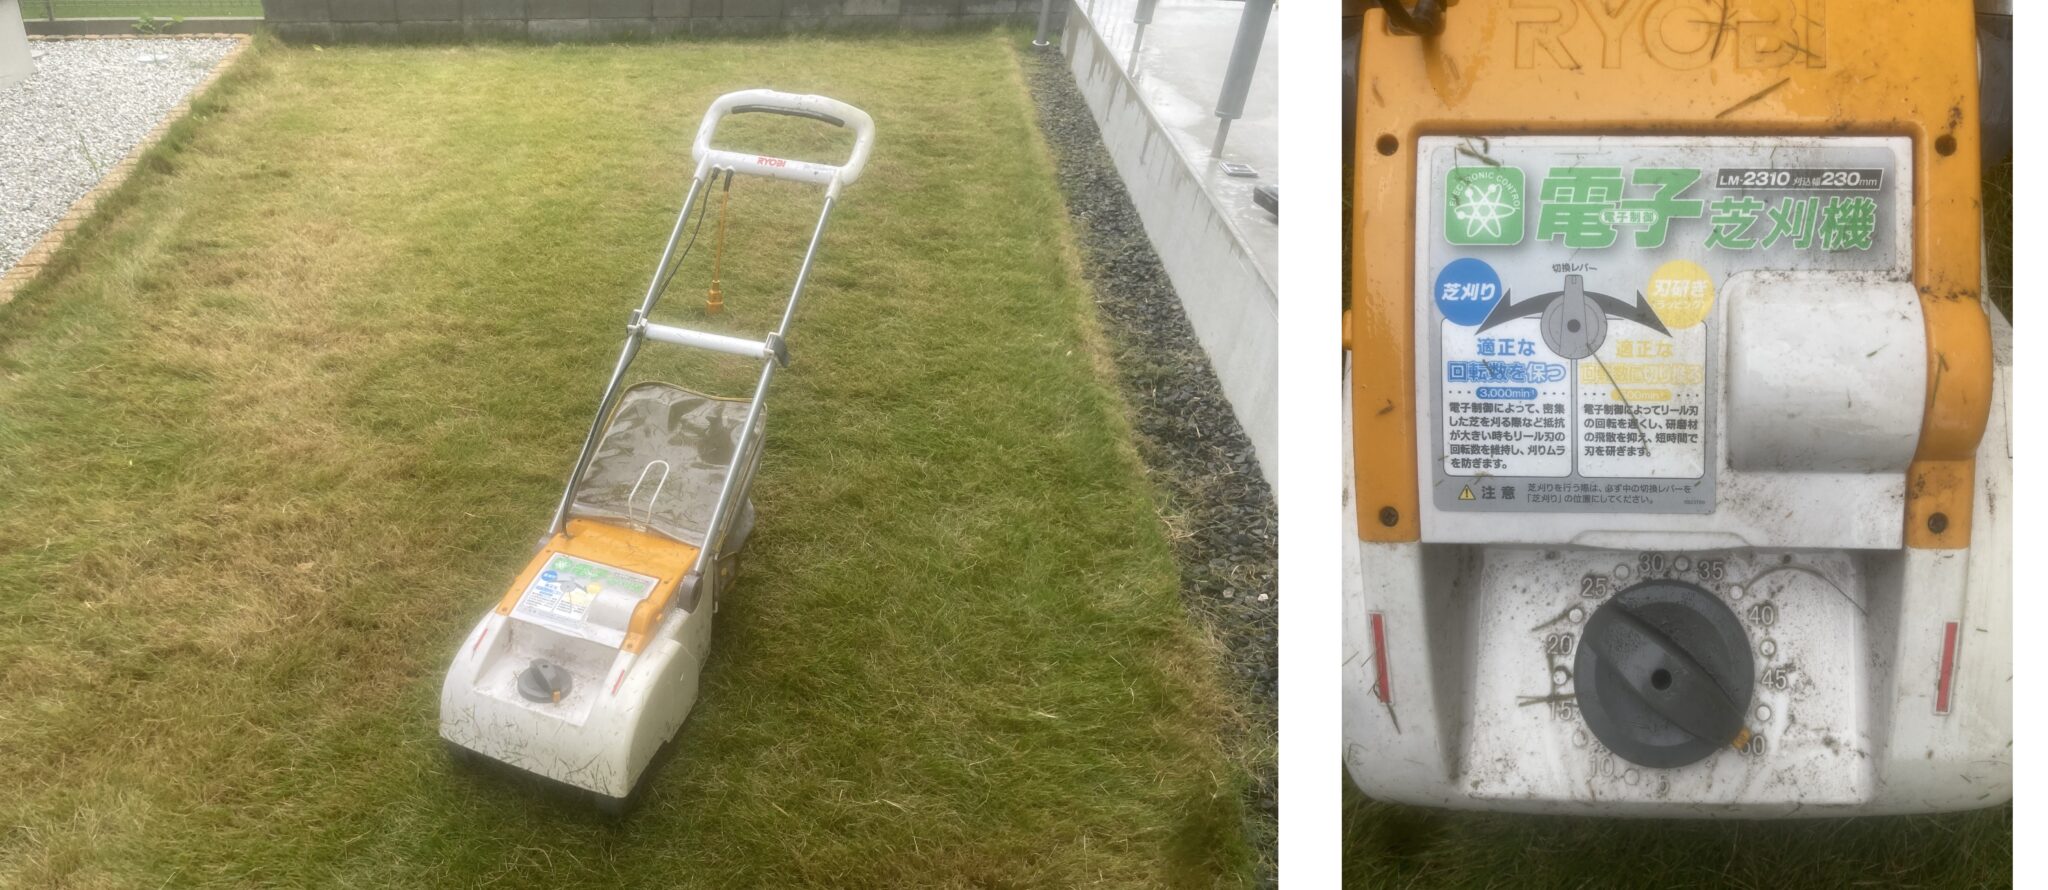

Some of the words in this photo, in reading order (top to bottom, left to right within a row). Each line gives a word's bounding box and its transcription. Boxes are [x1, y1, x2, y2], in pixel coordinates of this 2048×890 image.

[1509, 0, 1827, 71] RYOBI
[757, 157, 786, 167] RYOBI
[1719, 171, 1791, 187] LM-2310
[1704, 197, 1877, 250] 芝刈機
[1552, 263, 1598, 273] 切換レバー
[1441, 282, 1496, 301] 芝刈り
[1477, 338, 1536, 356] 適正な
[1447, 360, 1567, 383] 回転数を保つ
[1449, 402, 1565, 414] 電子制御によって、密集
[1449, 416, 1566, 428] した芝を刈る際など抵抗
[1449, 430, 1566, 442] が大きい時もリール刃の
[1584, 446, 1652, 457] 刃を研ぎます。
[1450, 458, 1507, 469] を防ぎます。
[1481, 485, 1516, 500] 注意
[1639, 553, 1665, 573] 30
[1699, 560, 1725, 581] 35
[1581, 577, 1608, 598] 25
[1749, 605, 1776, 626] 40
[1548, 634, 1574, 655] 20
[1761, 668, 1788, 690] 45
[1589, 755, 1615, 777] 10
